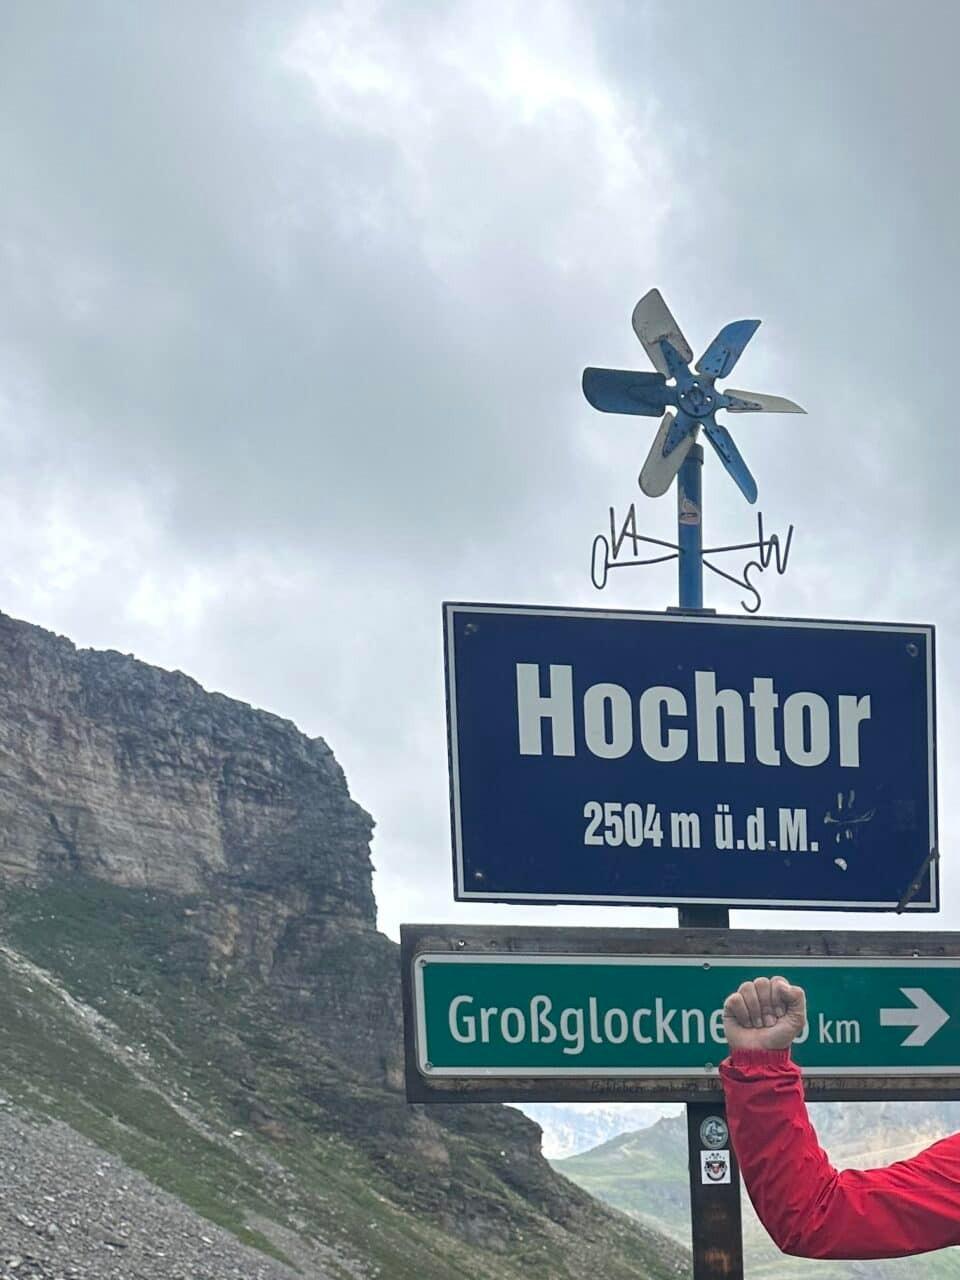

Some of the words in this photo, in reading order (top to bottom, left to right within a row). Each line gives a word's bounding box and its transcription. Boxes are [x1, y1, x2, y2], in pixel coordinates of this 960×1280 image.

[515, 662, 872, 769] Hochtor
[583, 800, 664, 849] 2504
[670, 814, 701, 849] m
[447, 994, 726, 1056] Großglockne
[818, 1013, 861, 1045] km
